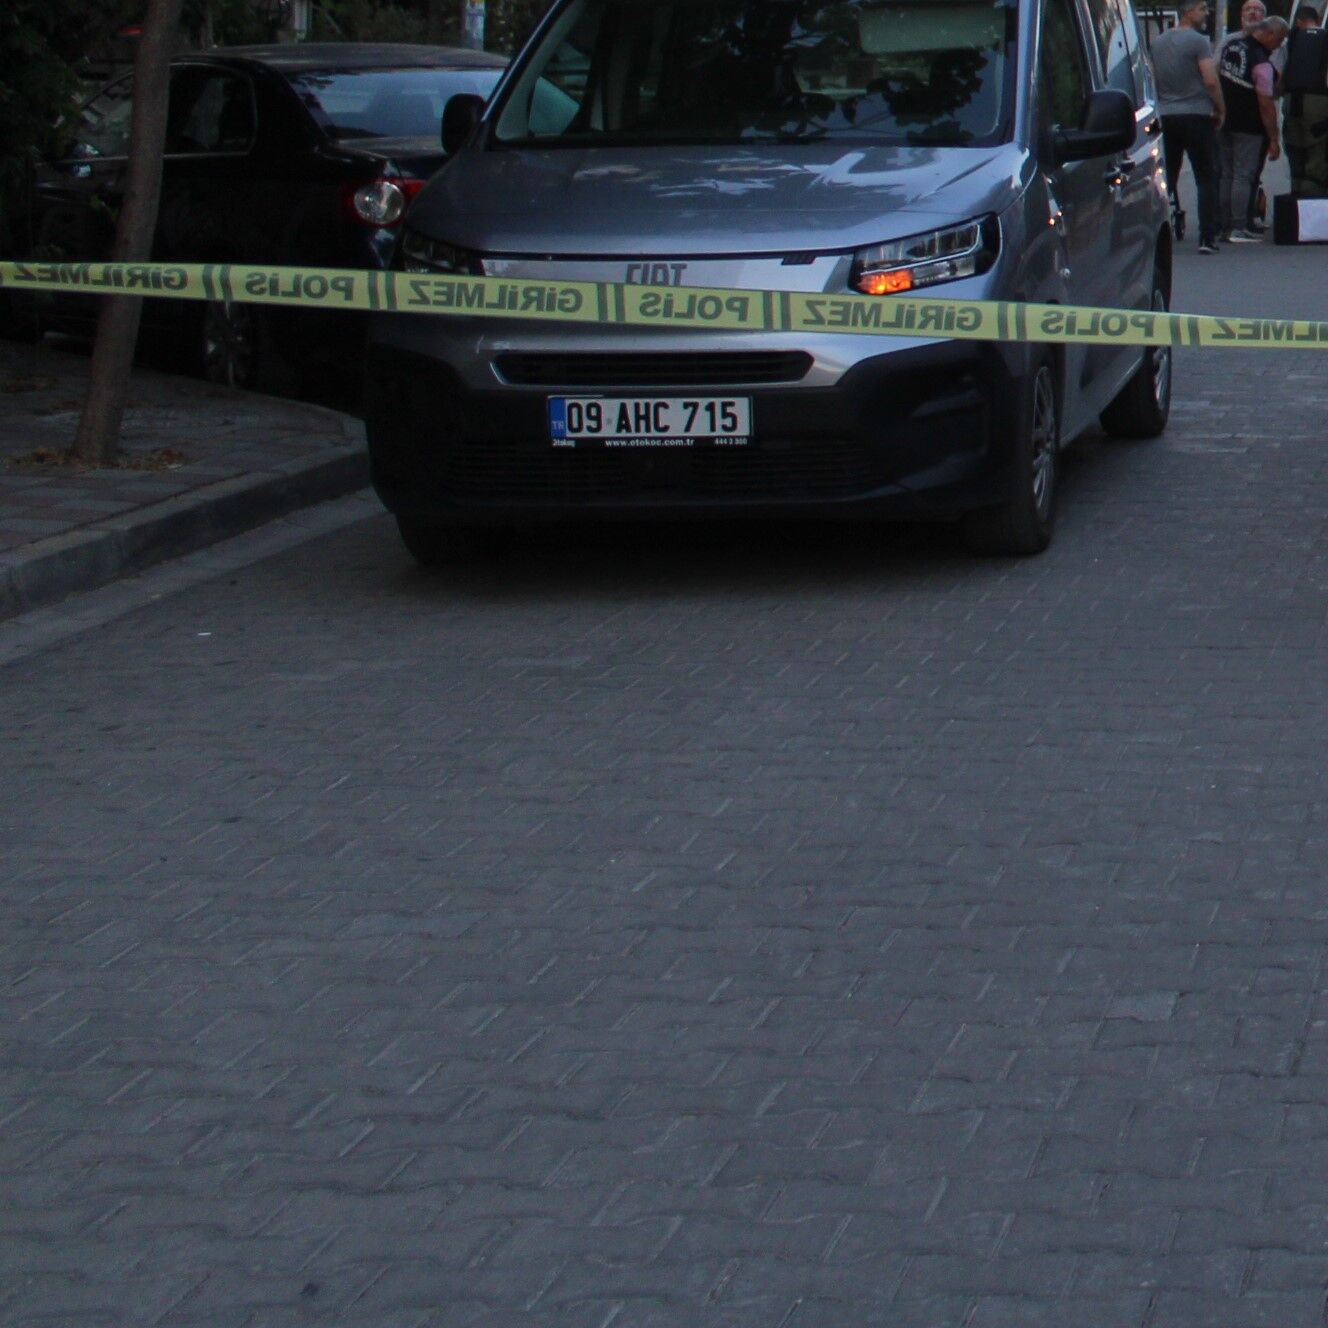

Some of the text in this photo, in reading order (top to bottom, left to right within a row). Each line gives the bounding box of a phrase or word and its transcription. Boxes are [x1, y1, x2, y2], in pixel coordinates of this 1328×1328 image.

[567, 401, 738, 433] 09 AHC 715
